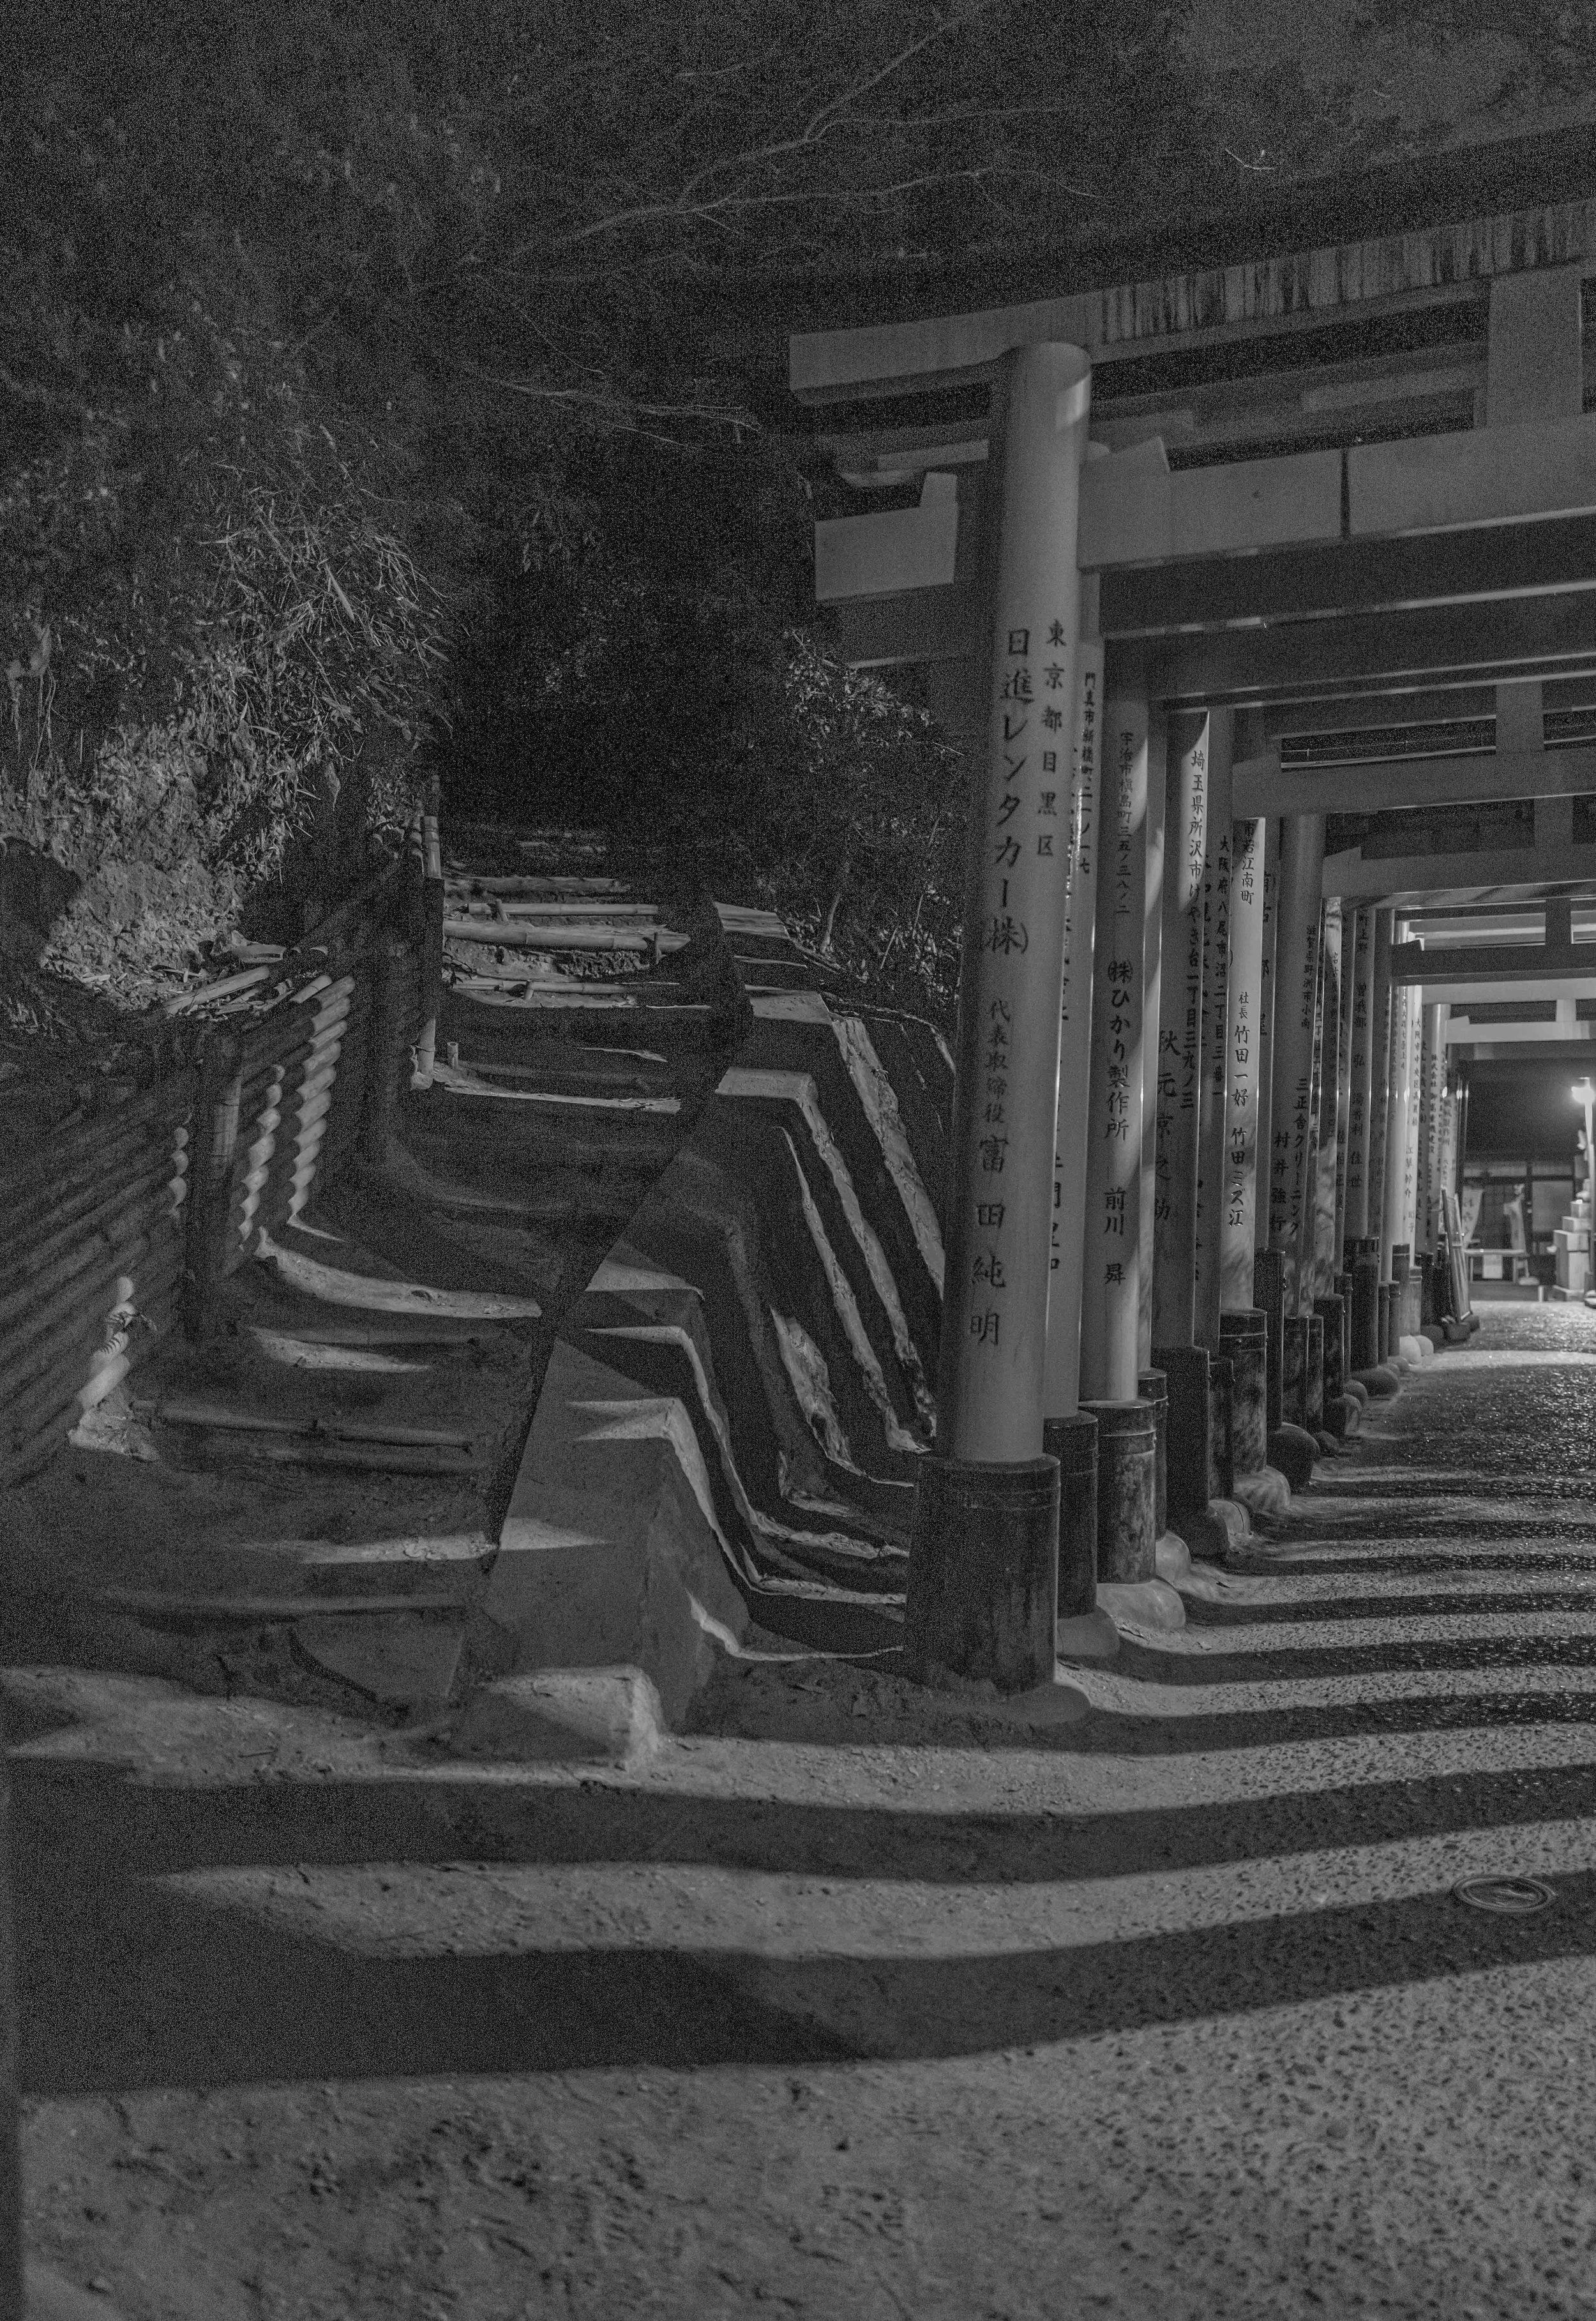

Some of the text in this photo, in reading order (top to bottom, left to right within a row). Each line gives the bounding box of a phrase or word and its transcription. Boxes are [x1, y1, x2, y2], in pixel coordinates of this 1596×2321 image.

[1037, 619, 1067, 857] 東京都目黒区
[984, 999, 1011, 1124] 代表取締役
[1231, 991, 1250, 1108] 社長 竹田一好
[1228, 1126, 1247, 1227] 竹田ミズ江
